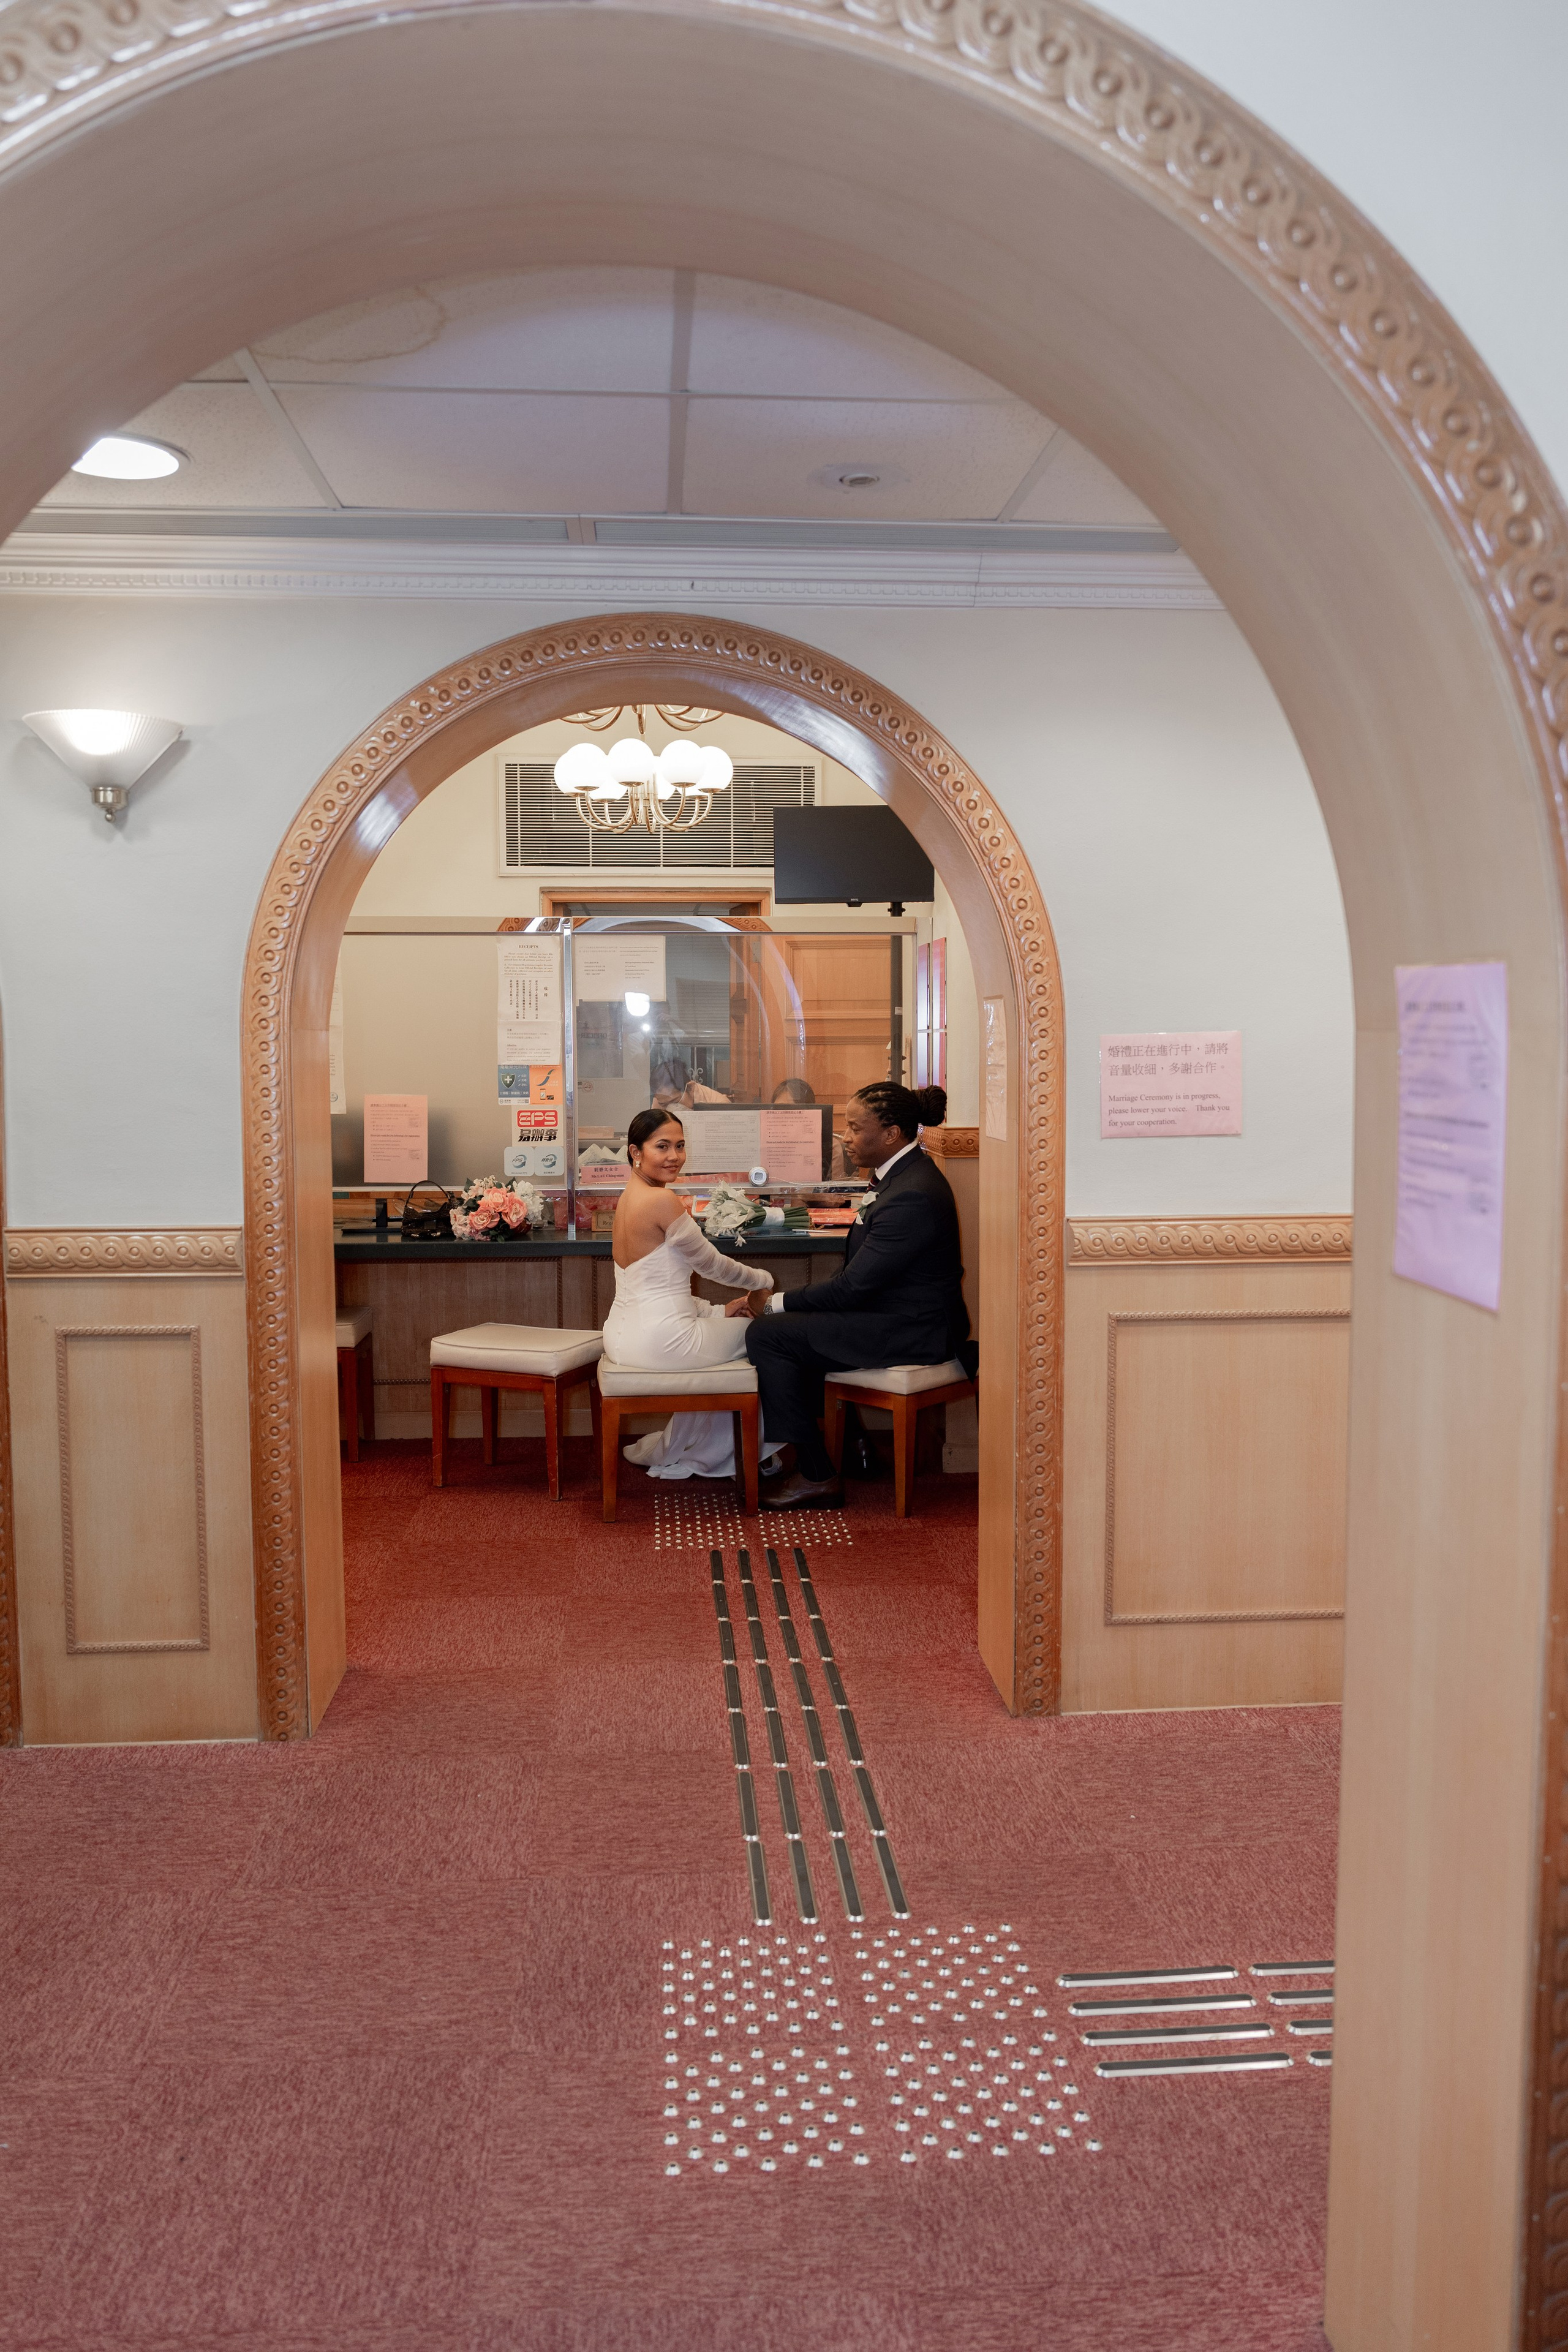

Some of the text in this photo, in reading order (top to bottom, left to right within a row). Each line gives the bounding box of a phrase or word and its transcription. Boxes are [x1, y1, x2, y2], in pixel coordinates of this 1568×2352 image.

[1108, 1043, 1229, 1058] 婚禮正在進行中，請將
[1108, 1061, 1224, 1076] 音量收細，多謝合作。
[519, 1112, 556, 1125] EPS
[518, 1129, 558, 1142] 易辦事
